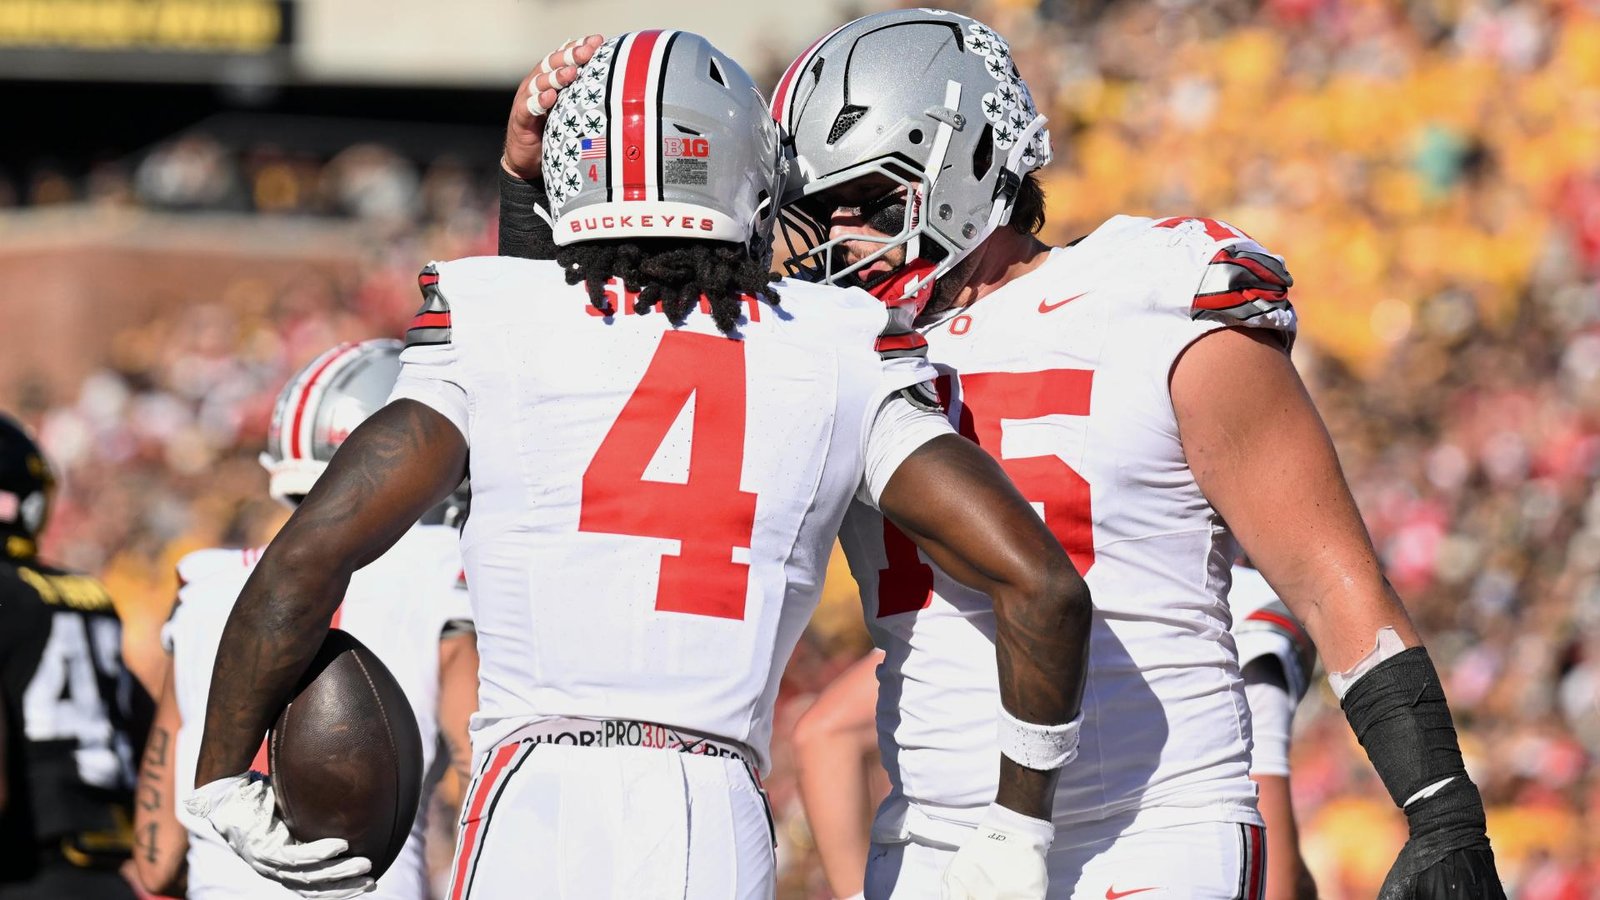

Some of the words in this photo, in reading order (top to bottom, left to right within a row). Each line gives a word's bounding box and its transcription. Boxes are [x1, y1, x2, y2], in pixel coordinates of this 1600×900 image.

[588, 164, 598, 183] 4
[570, 215, 714, 233] BUCKEYES
[578, 330, 758, 621] 4
